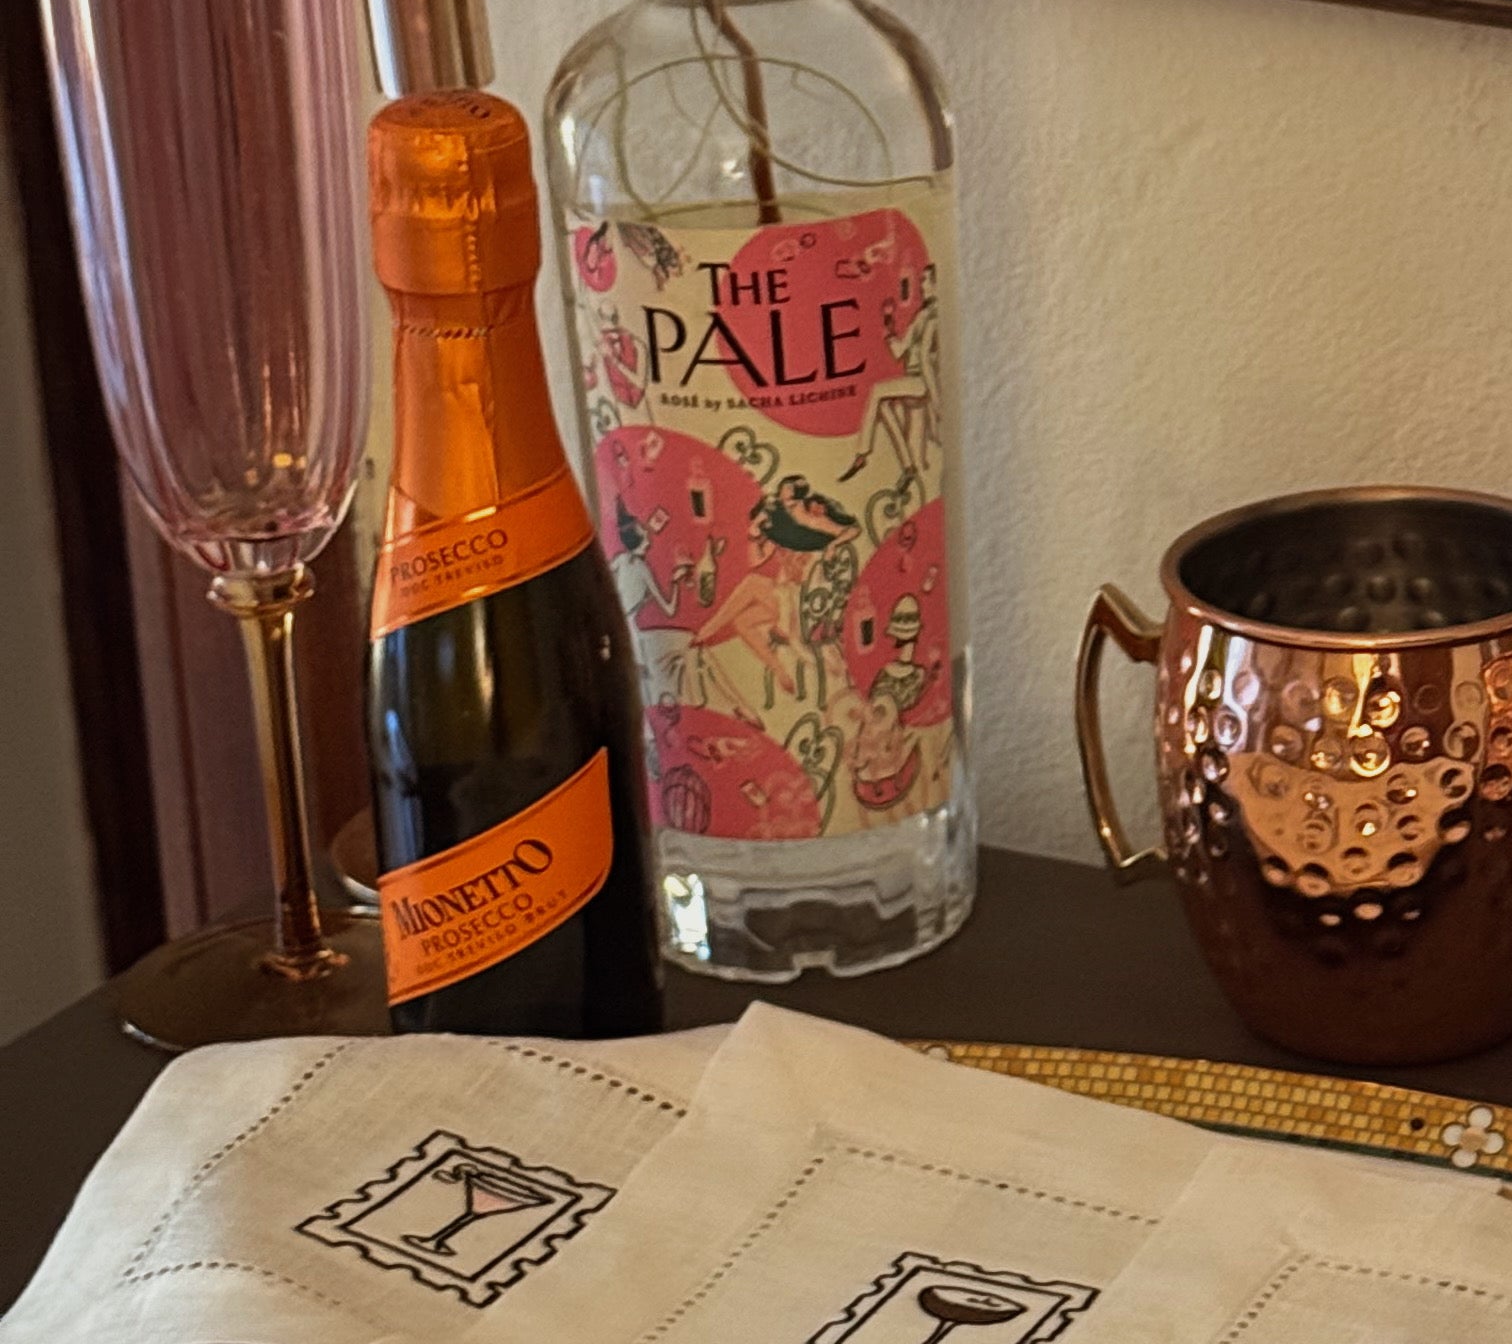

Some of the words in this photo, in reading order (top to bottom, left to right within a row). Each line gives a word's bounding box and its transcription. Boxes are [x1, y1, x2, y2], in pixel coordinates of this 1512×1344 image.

[696, 262, 789, 307] THE
[641, 298, 867, 387] PALE
[390, 529, 508, 584] PROSECCO
[391, 839, 553, 940] MIONETTO
[420, 893, 533, 955] PROSECCO
